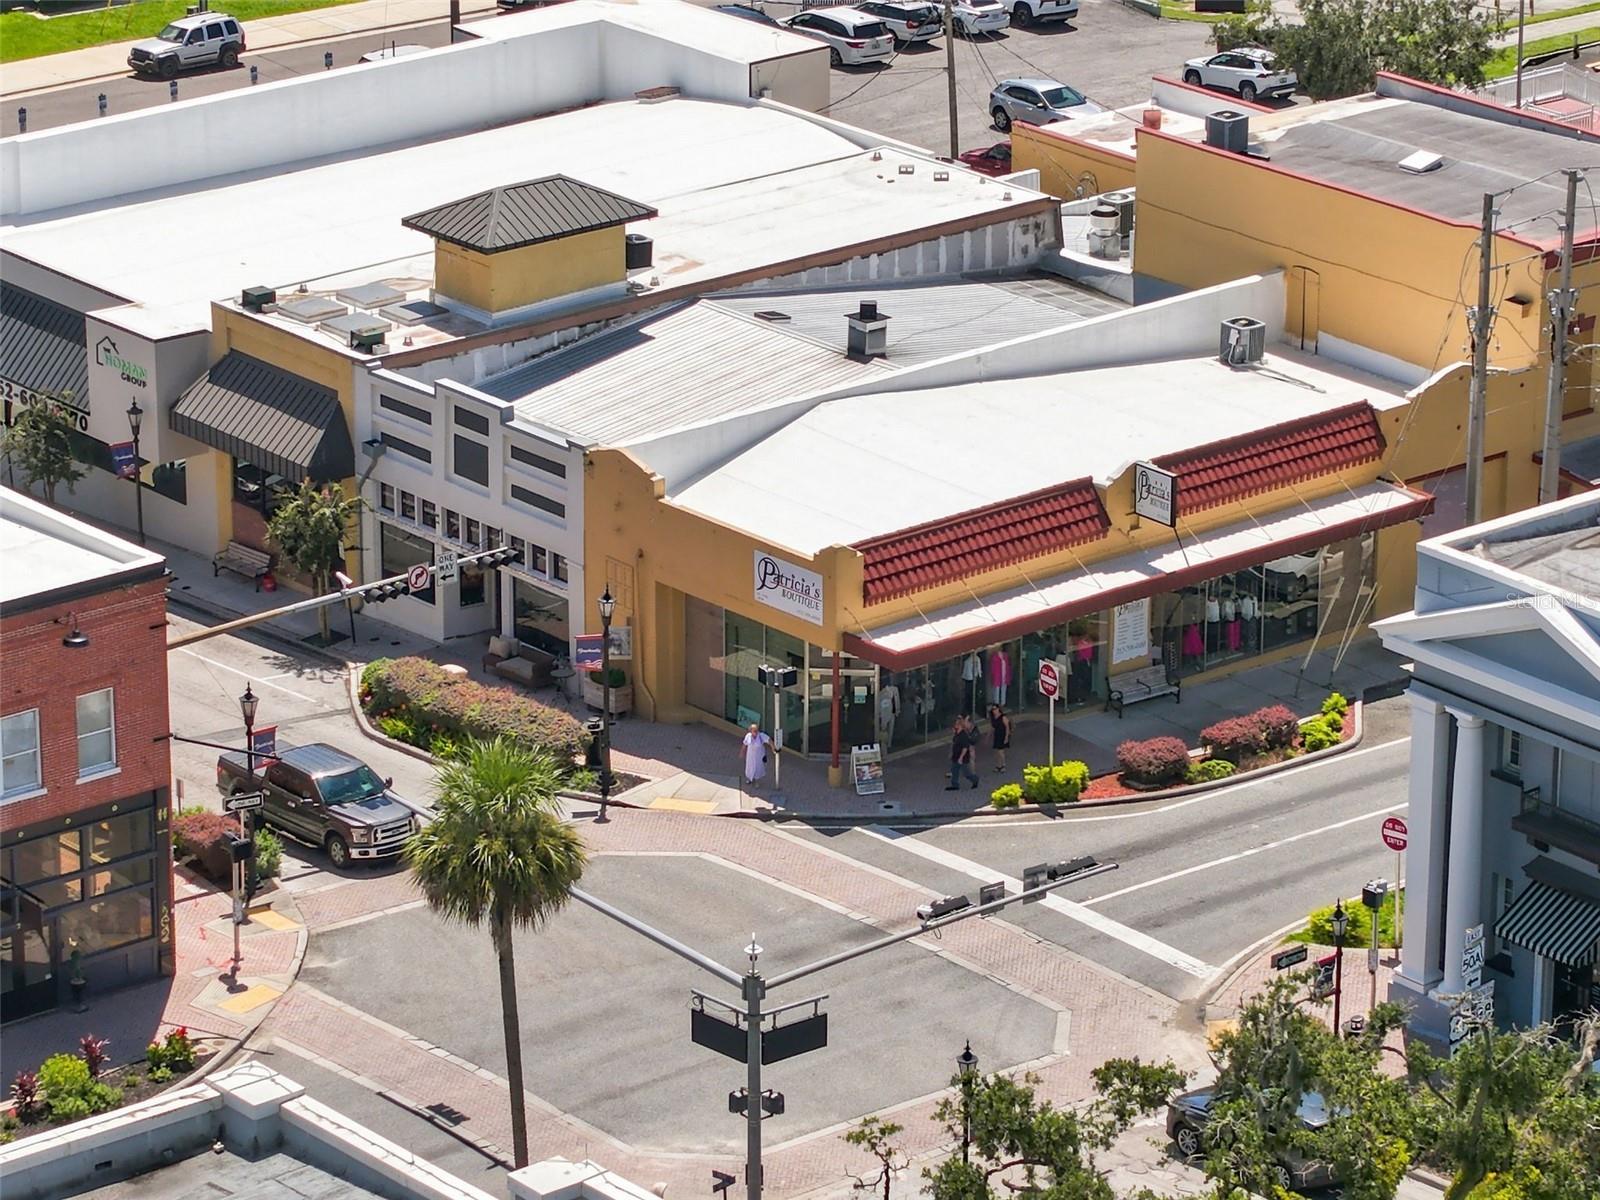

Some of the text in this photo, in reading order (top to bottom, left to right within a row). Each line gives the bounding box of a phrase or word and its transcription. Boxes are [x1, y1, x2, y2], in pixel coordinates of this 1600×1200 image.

[104, 353, 147, 379] HOMAN
[121, 372, 147, 388] GROUP
[439, 553, 454, 563] ONE
[439, 562, 454, 572] WAY
[756, 557, 821, 598] Patricia's
[782, 589, 820, 611] BOUTIQUE
[1462, 952, 1481, 973] 50A
